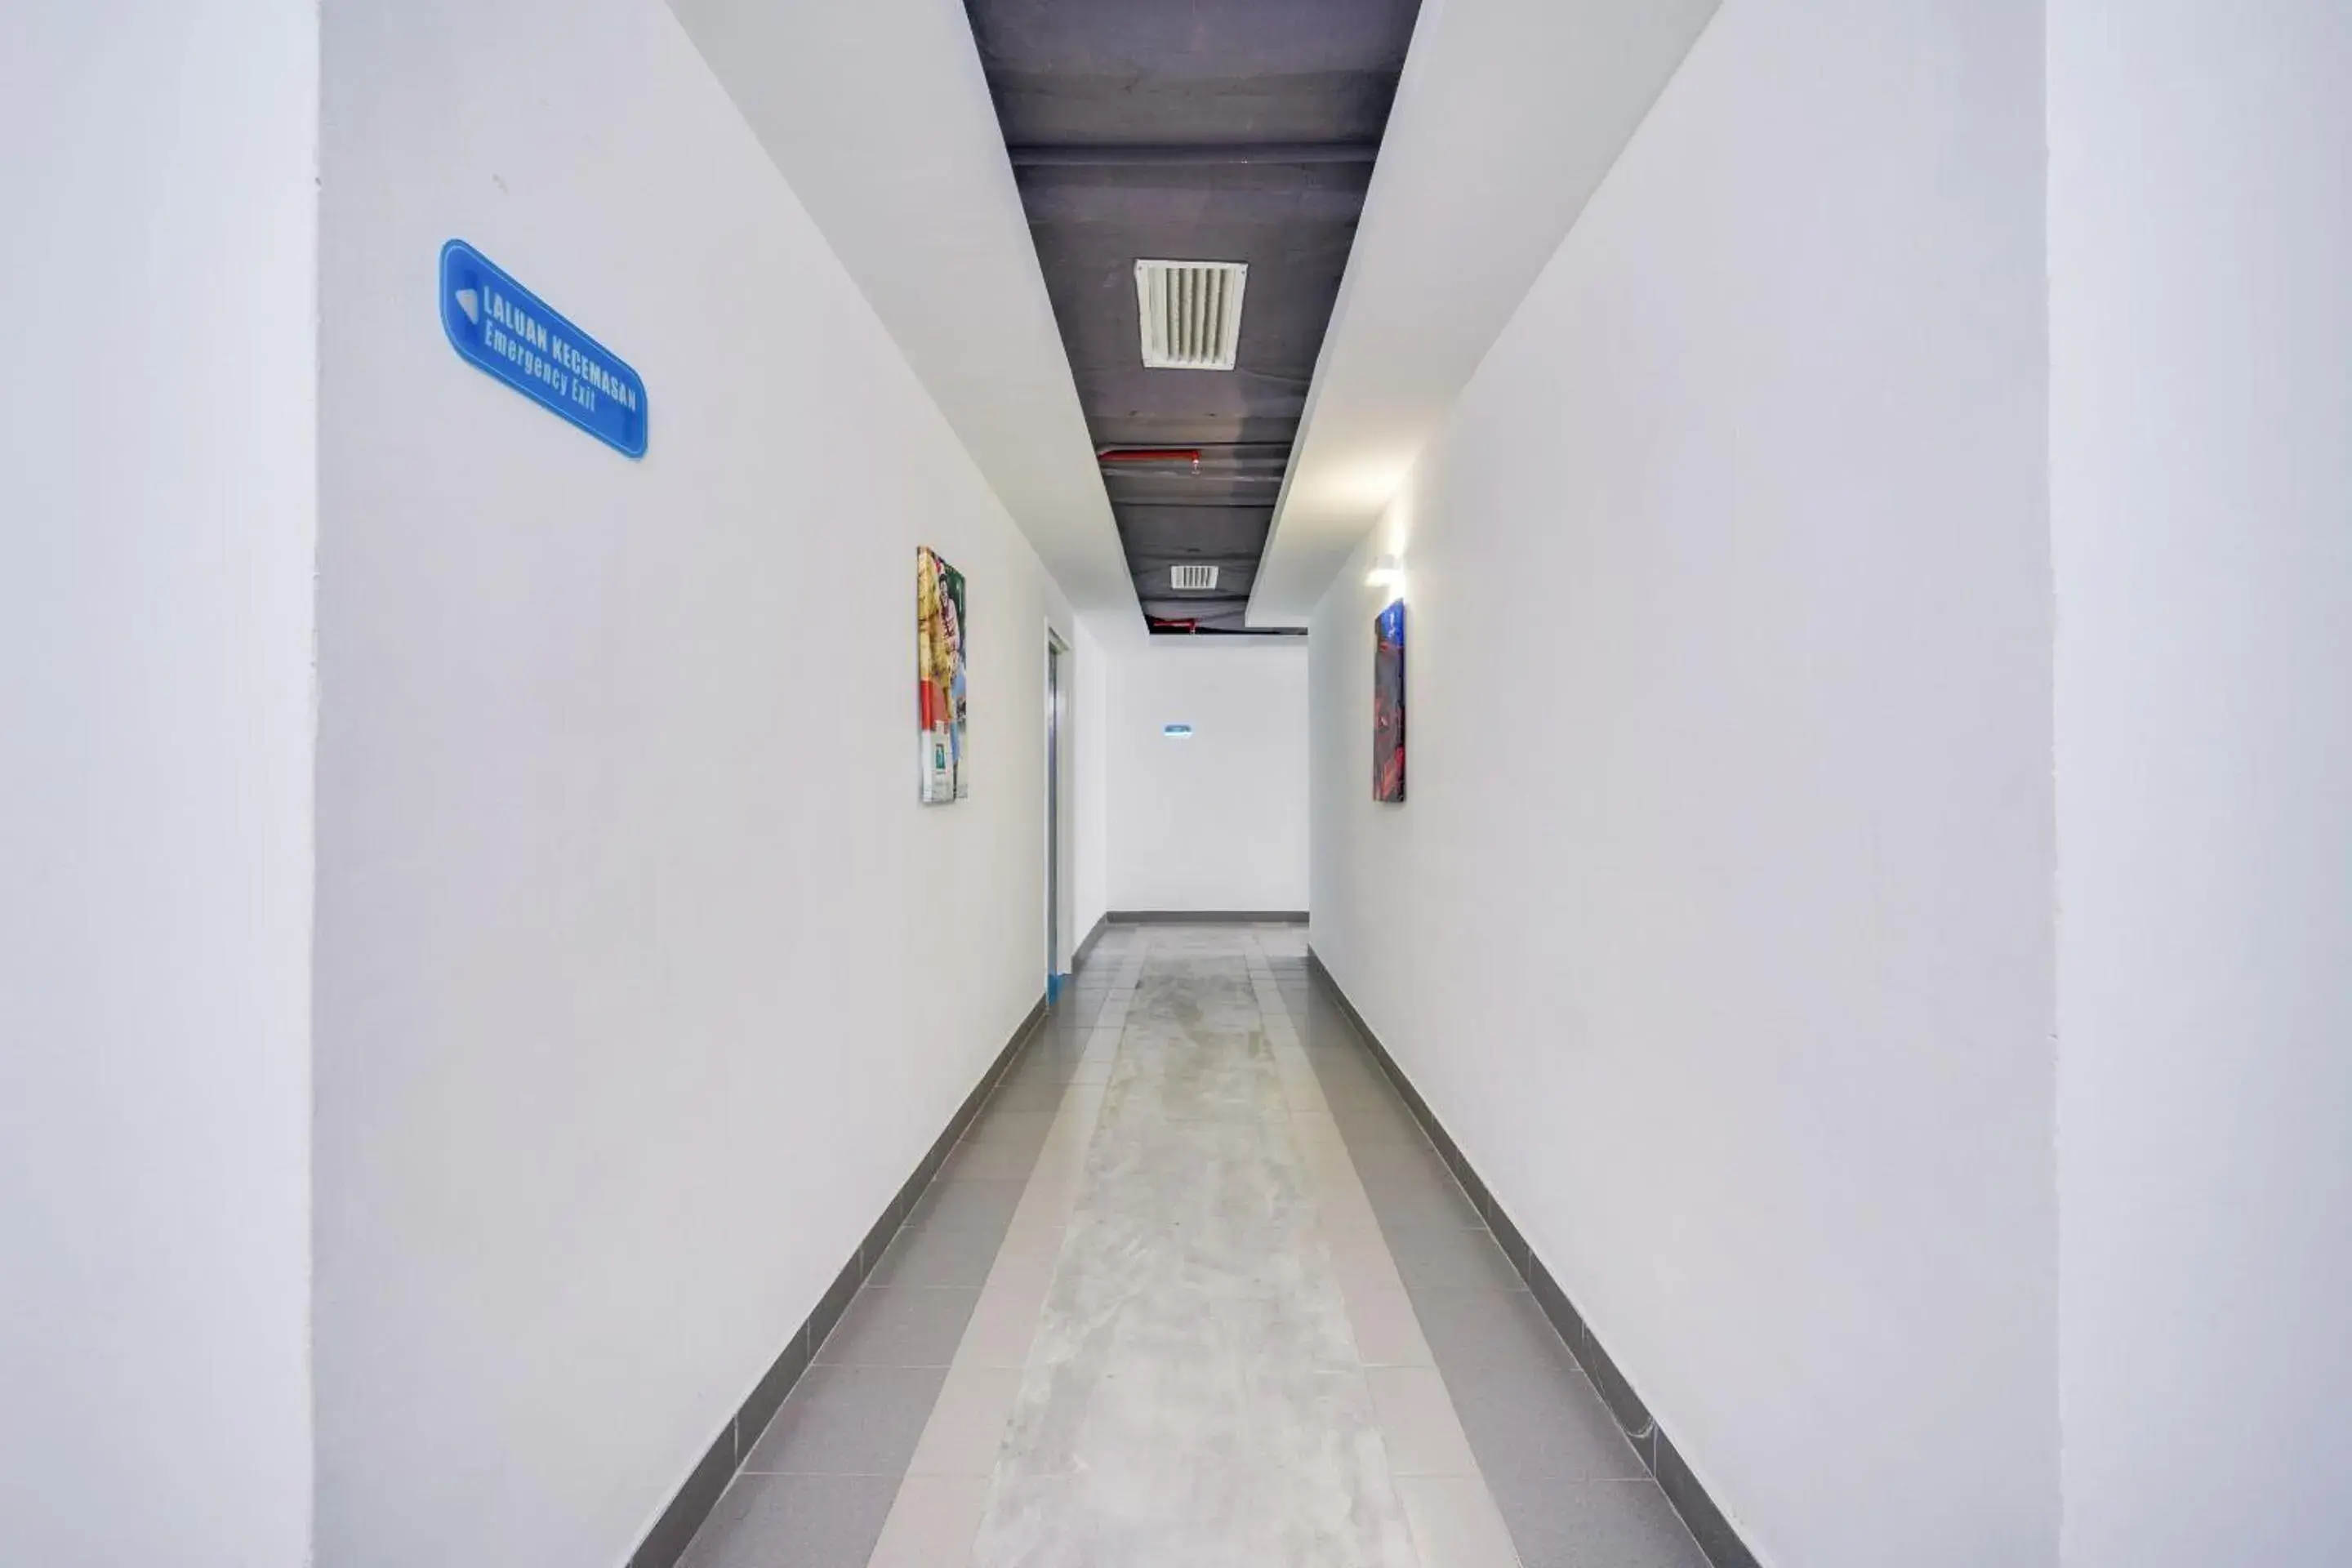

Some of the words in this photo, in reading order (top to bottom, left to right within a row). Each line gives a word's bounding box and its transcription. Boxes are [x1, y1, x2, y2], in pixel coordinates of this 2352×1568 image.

[483, 286, 548, 352] LALUAN
[552, 335, 637, 412] KECEMASAN
[485, 318, 568, 396] Emergency
[572, 378, 595, 412] Exit
